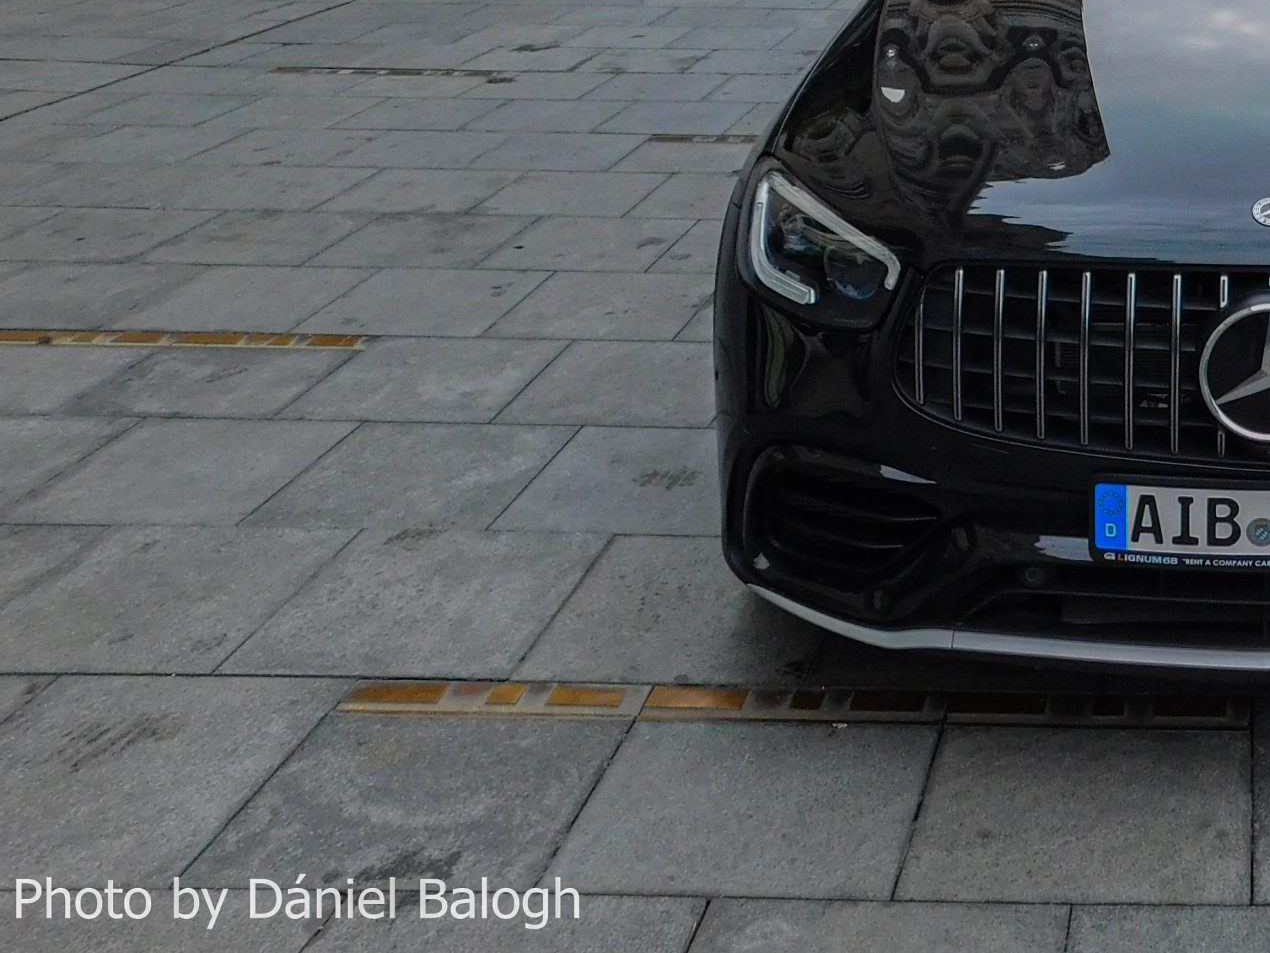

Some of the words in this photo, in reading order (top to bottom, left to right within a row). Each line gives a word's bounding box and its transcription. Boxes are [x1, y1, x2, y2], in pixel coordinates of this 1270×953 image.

[1105, 522, 1117, 538] D
[1131, 495, 1242, 547] AIB
[1212, 559, 1254, 567] COMPANY
